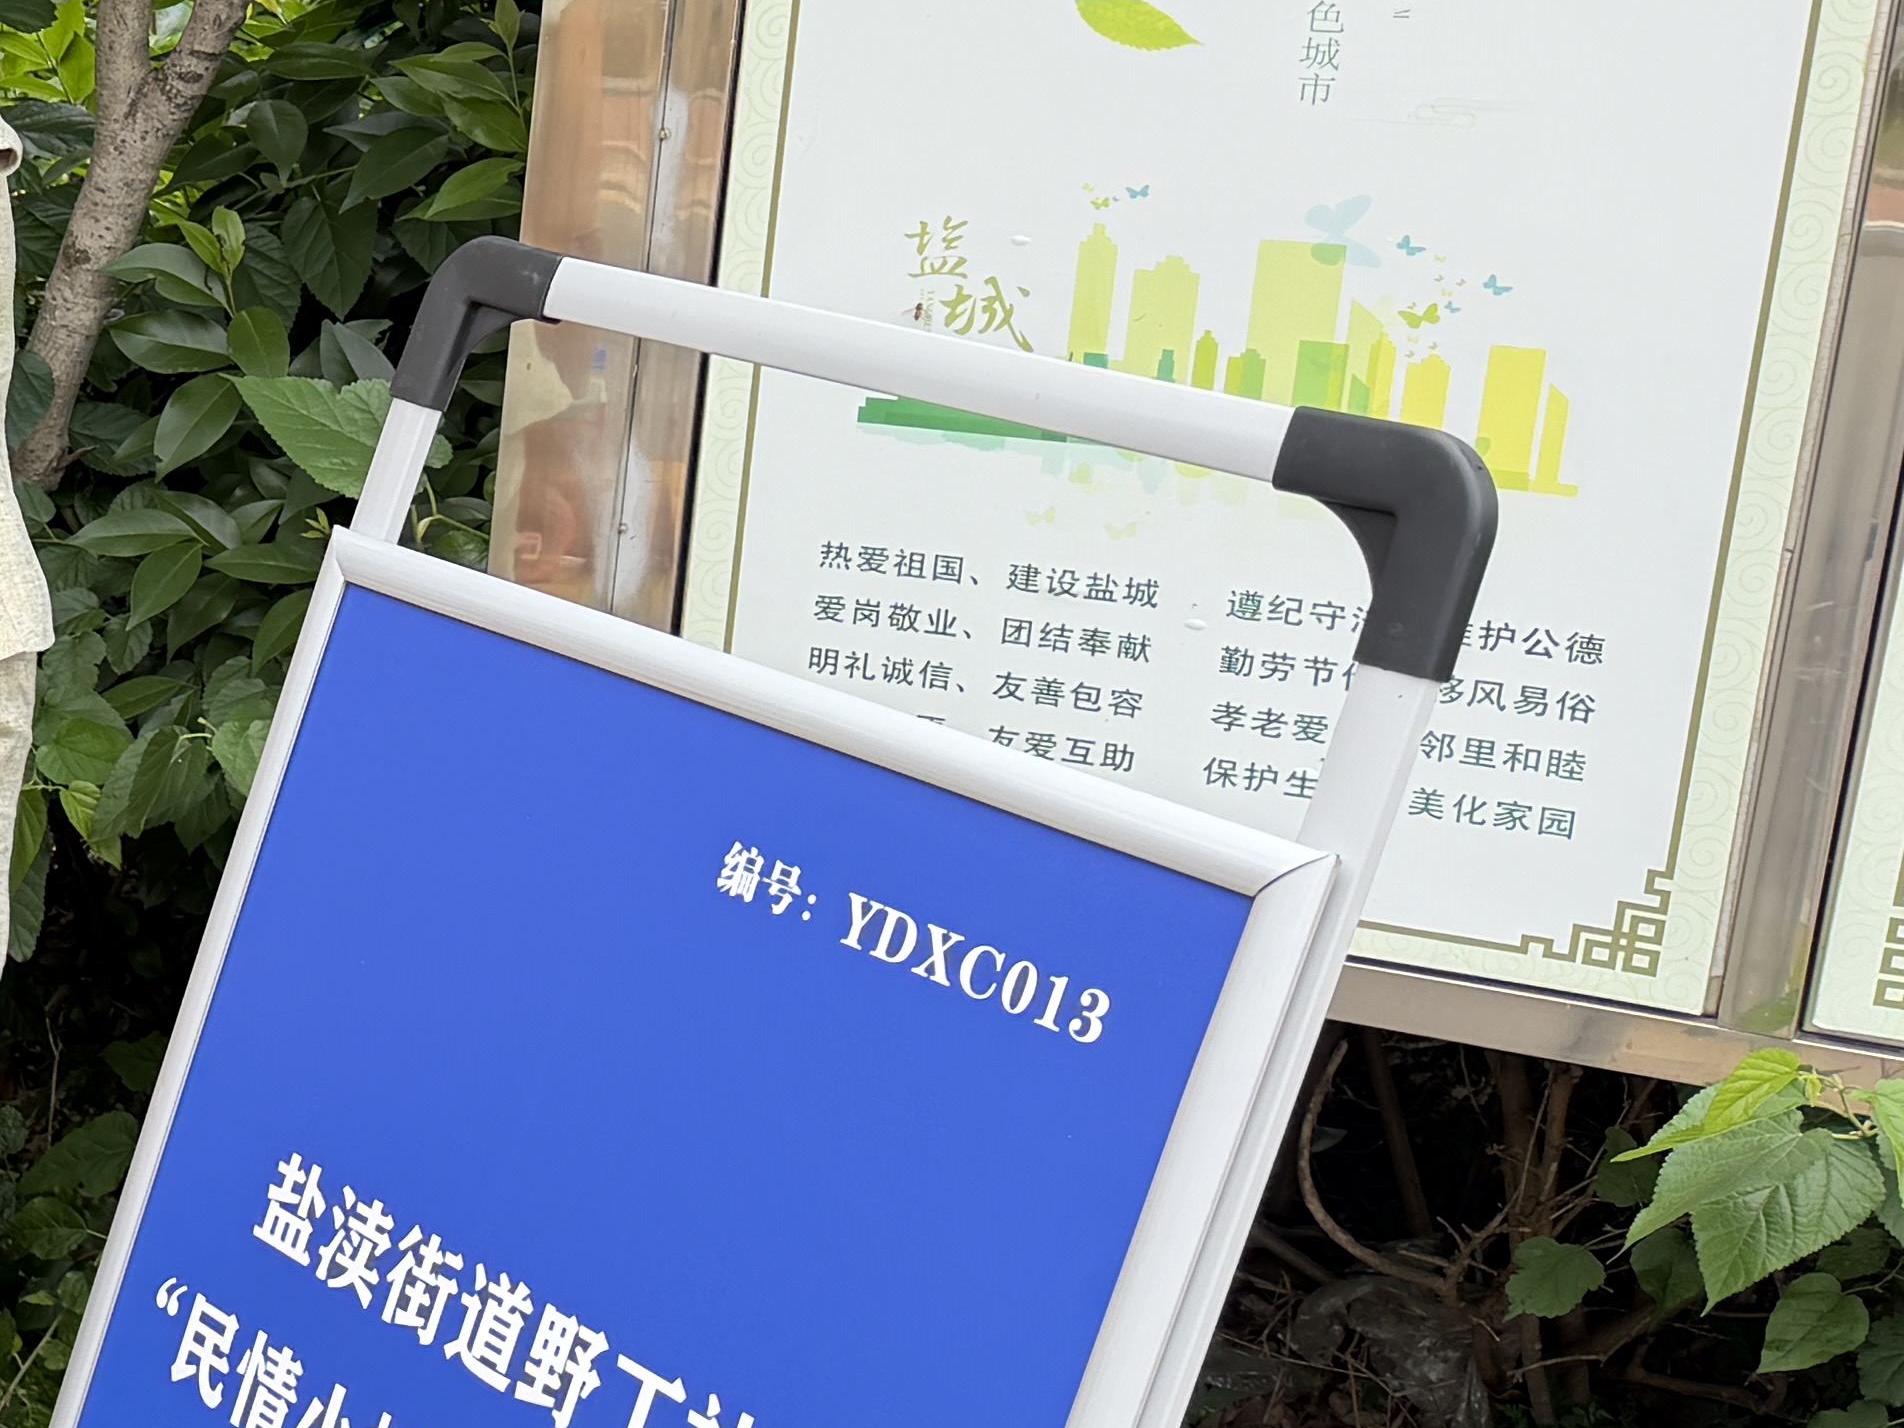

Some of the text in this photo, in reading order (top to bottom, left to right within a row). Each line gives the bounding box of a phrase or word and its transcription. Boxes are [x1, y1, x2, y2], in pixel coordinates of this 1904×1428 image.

[819, 539, 1160, 610] 热爱祖国、建设盐城
[812, 593, 1153, 664] 爱岗敬业、团结奉献
[807, 646, 1144, 719] 明礼诚信、友善包容
